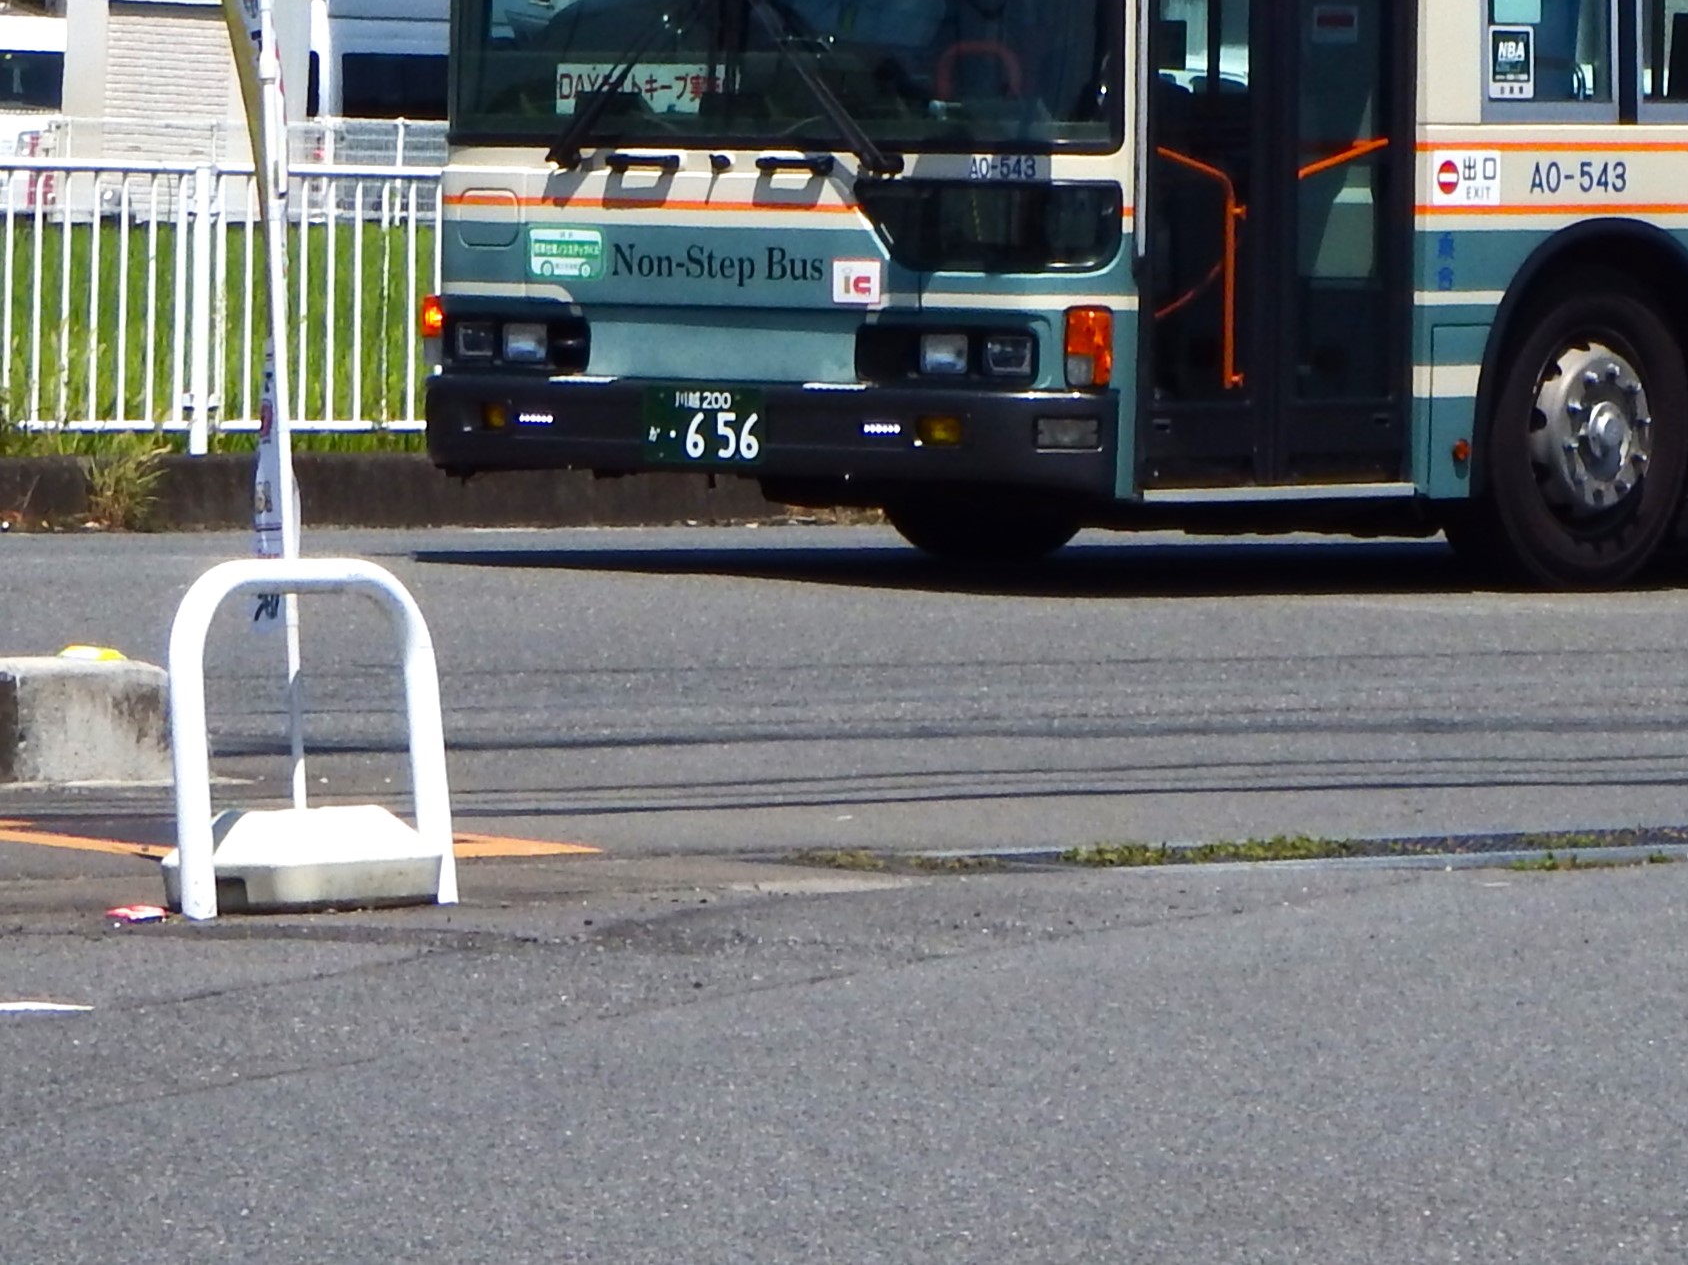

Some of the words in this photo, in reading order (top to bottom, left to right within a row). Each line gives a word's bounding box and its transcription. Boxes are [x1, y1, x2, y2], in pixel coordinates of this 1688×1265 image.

[1462, 156, 1497, 181] 出口
[1465, 186, 1491, 200] EXIT
[611, 243, 755, 287] Non-Step
[765, 246, 823, 282] Bus
[702, 391, 732, 409] 200
